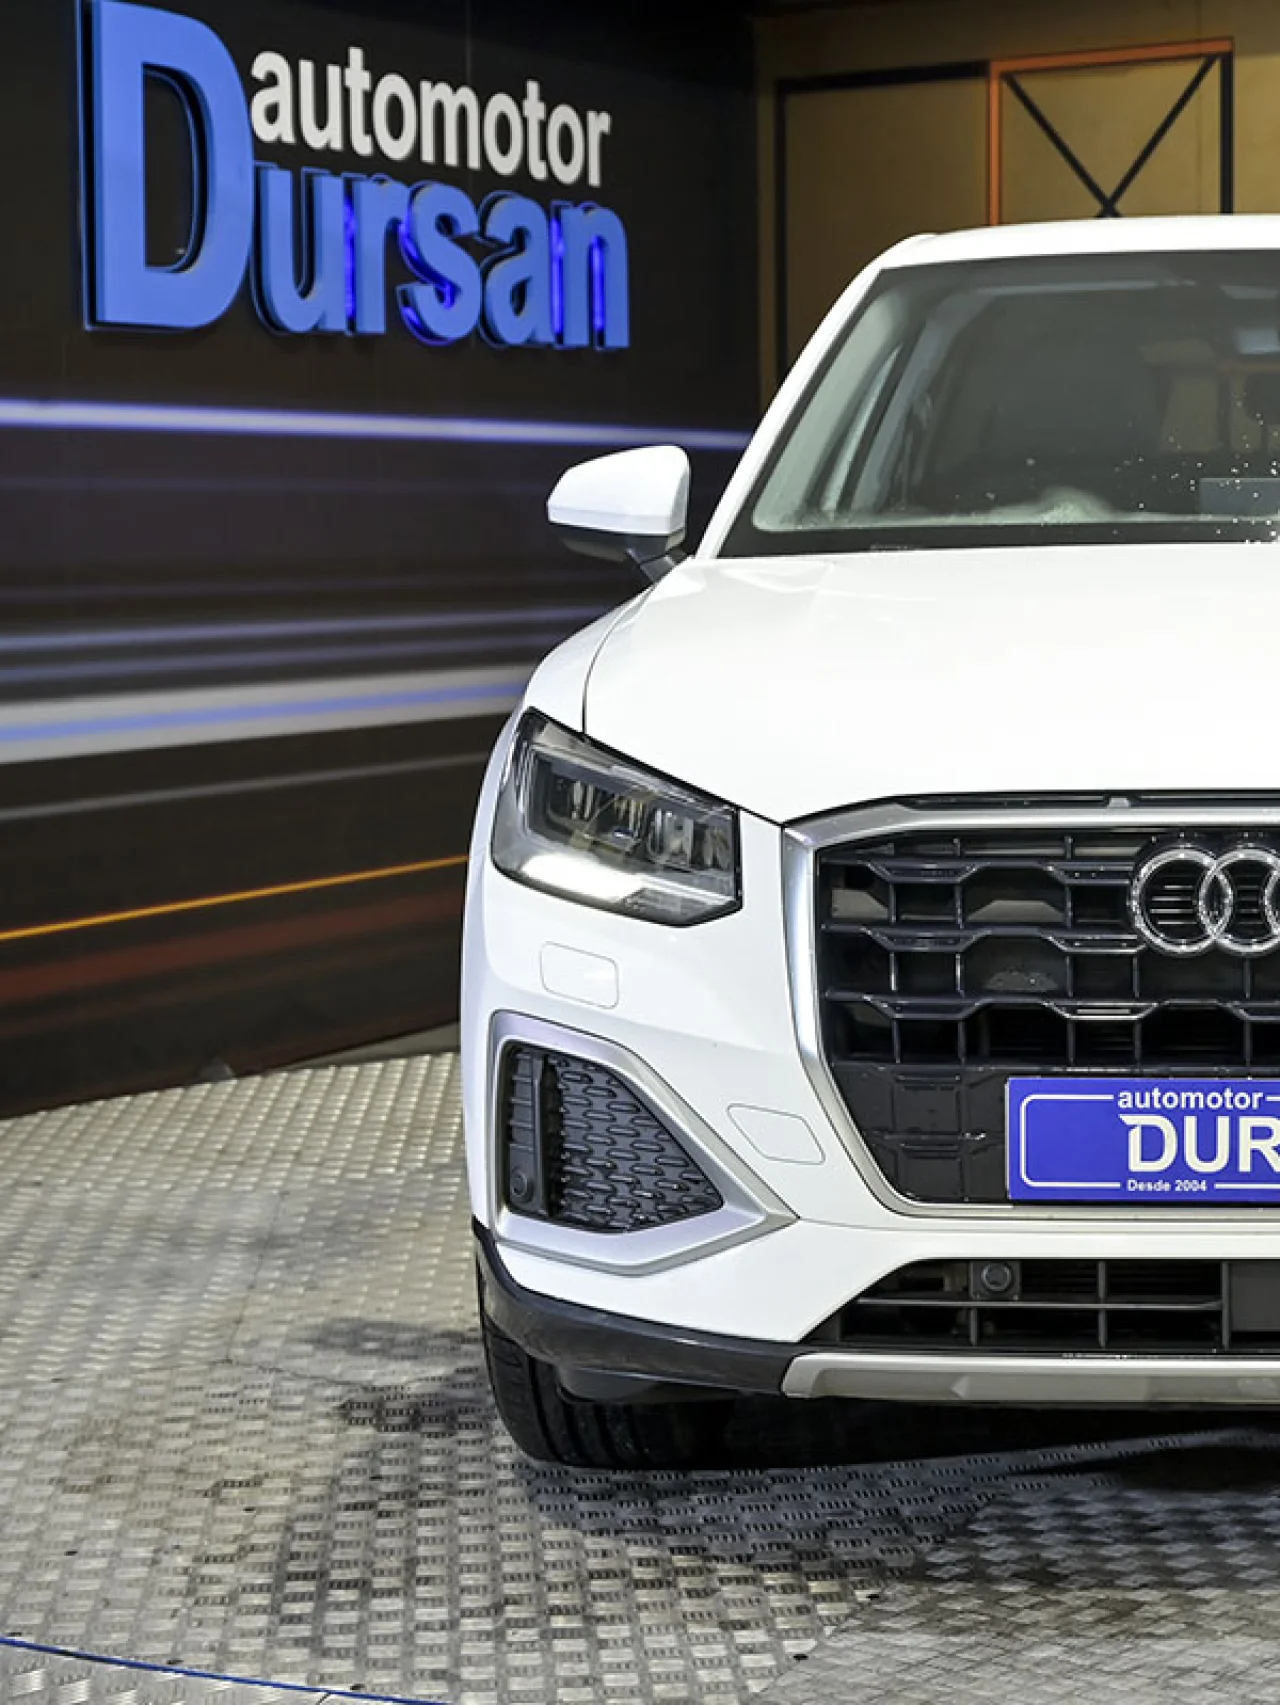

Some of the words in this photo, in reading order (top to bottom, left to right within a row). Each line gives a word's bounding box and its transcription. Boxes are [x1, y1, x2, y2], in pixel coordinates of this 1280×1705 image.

[251, 46, 611, 187] automotor
[78, 0, 630, 350] Dursan
[1117, 1087, 1263, 1110] automotor
[1127, 1179, 1171, 1192] Desde
[1174, 1179, 1207, 1192] 2004
